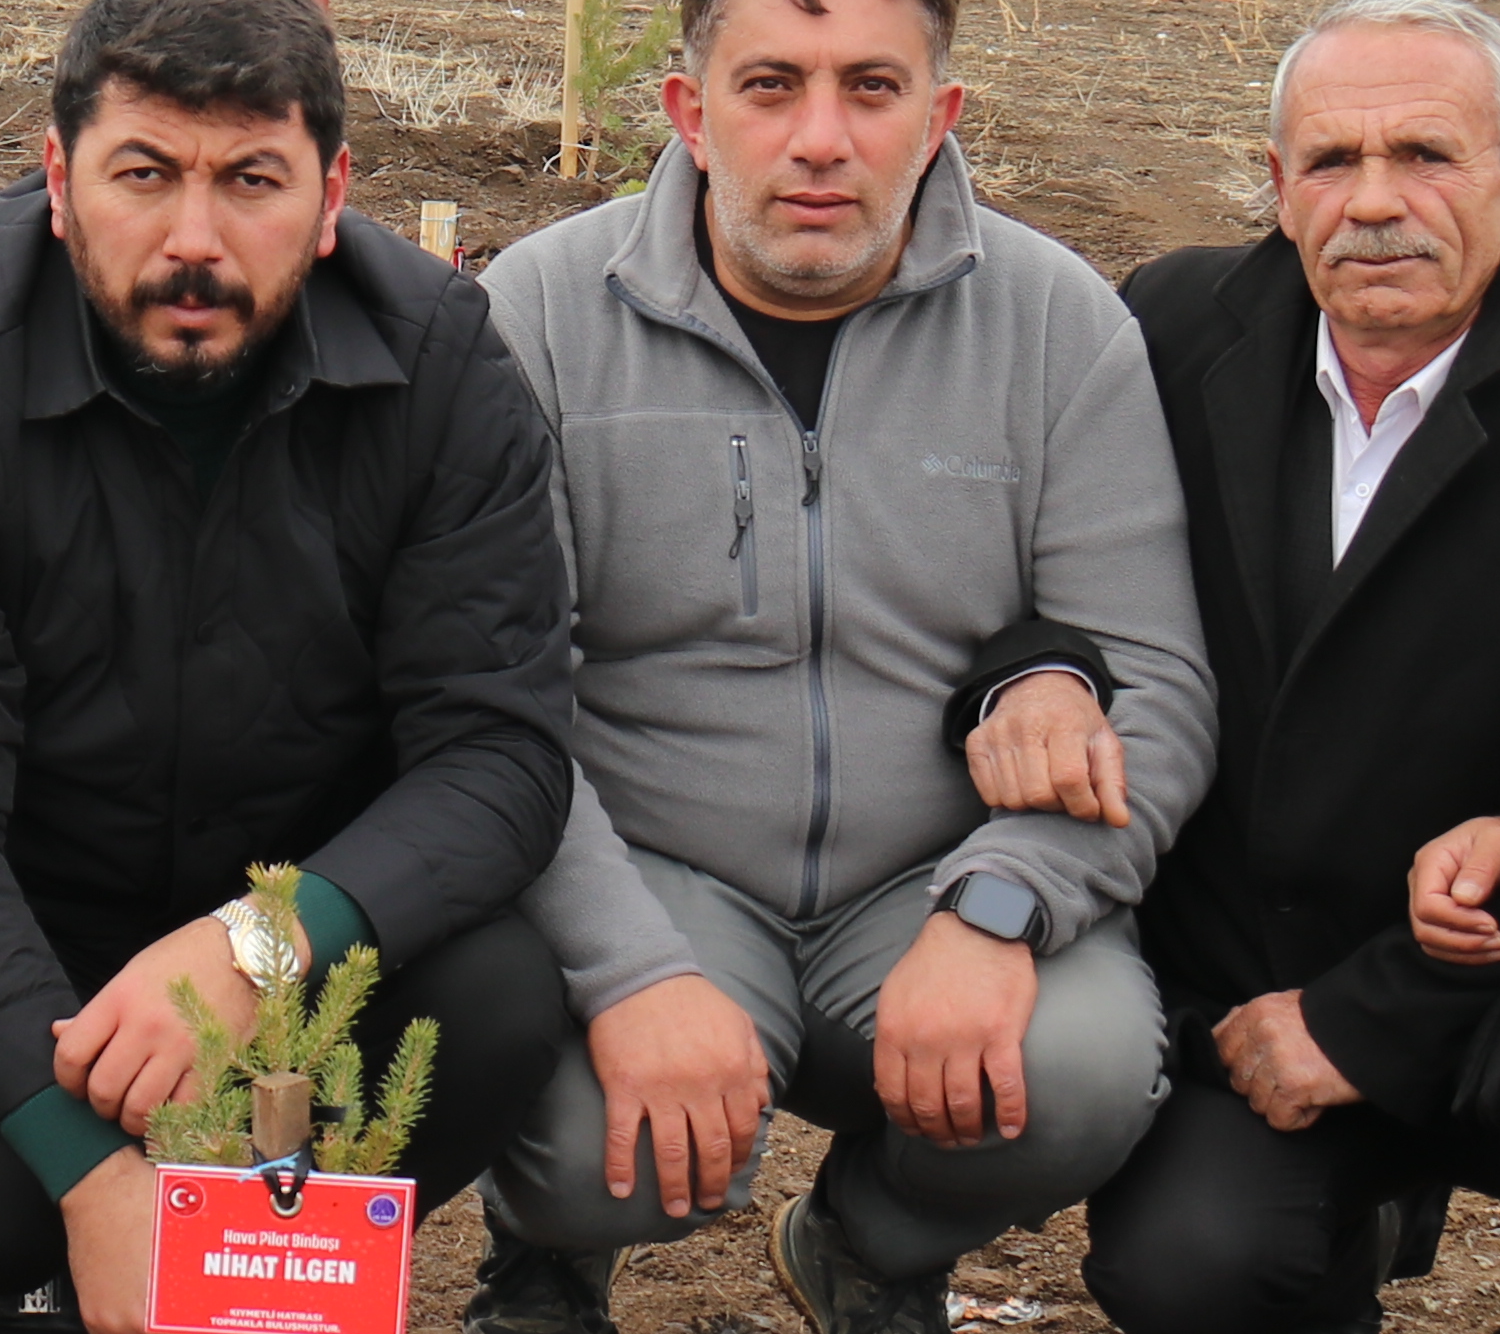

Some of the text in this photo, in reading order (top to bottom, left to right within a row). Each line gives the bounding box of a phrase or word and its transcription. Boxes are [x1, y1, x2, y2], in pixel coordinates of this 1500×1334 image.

[944, 455, 1020, 482] Columbia
[223, 1229, 340, 1252] Hava Pilot Binbaşı
[203, 1247, 357, 1284] NİHAT İLGEN
[210, 1317, 264, 1329] TOPRAKLA
[229, 1308, 323, 1322] KIYMETLİ HATIRASI
